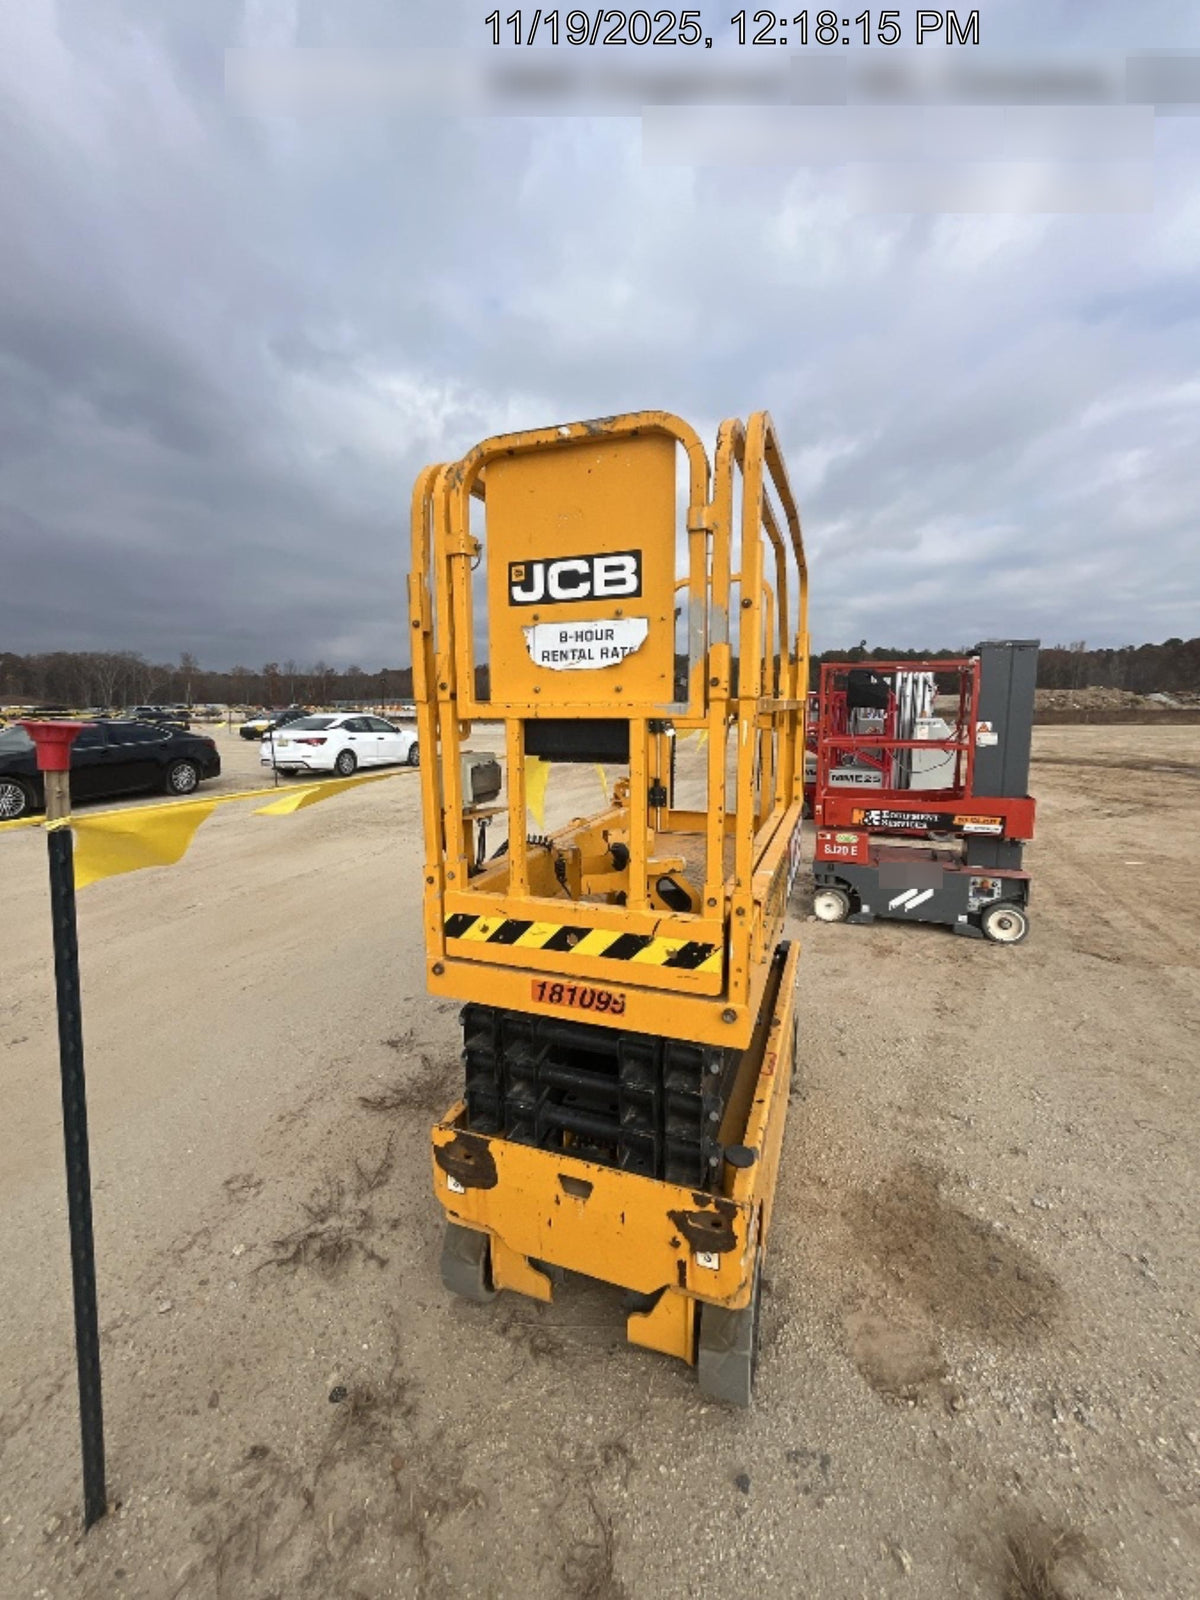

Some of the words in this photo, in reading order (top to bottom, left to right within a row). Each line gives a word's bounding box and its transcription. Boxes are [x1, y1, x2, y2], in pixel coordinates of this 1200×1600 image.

[511, 555, 638, 602] JCB
[559, 628, 615, 643] 8-HOUR
[541, 648, 595, 662] RENTAL
